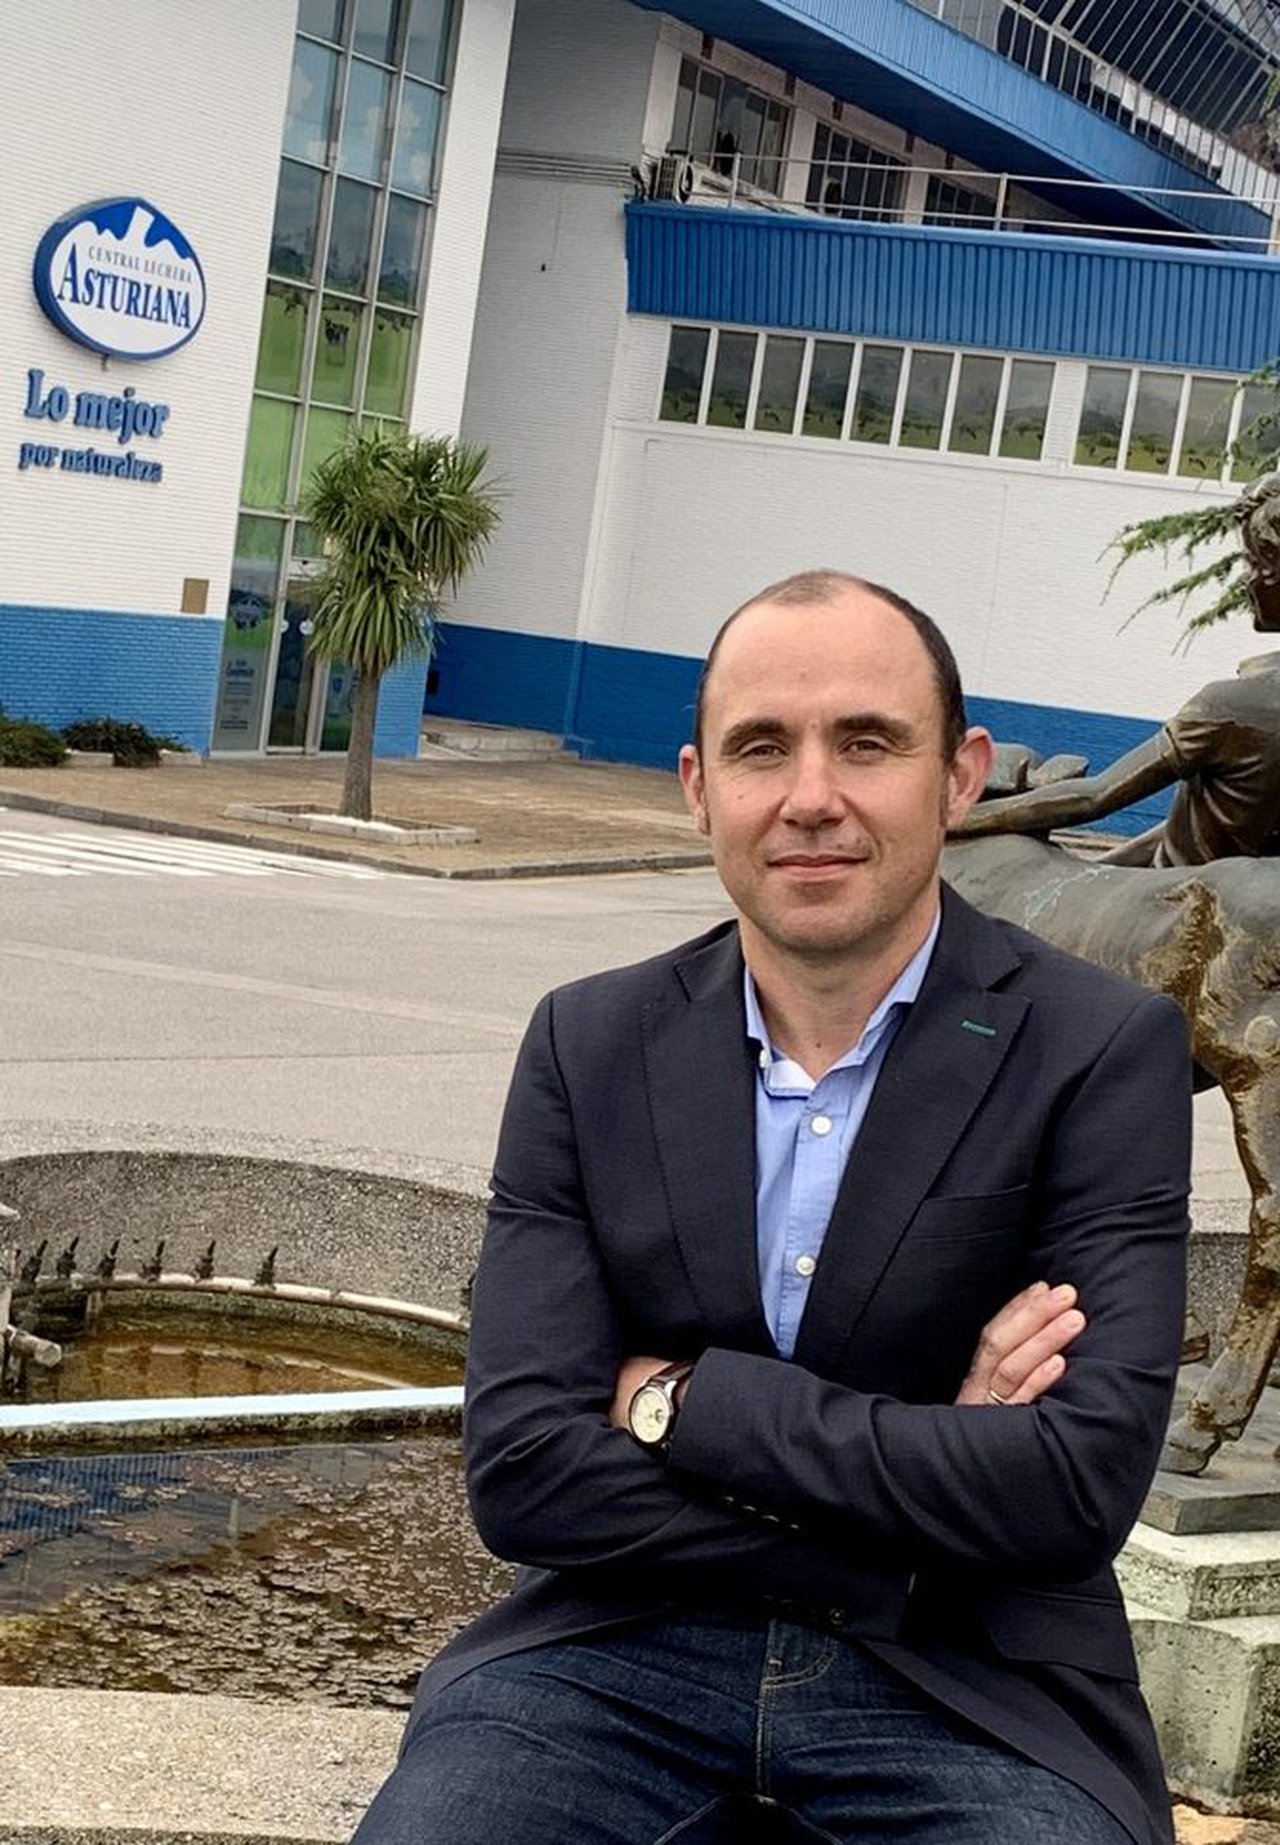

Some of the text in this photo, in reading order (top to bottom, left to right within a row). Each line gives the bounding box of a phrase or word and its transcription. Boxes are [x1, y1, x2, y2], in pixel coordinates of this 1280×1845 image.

[57, 243, 191, 329] ASTURIANA
[88, 246, 192, 283] CENTRAL LECHERA
[24, 368, 170, 445] Lo mejor
[18, 442, 163, 484] por naturaleza
